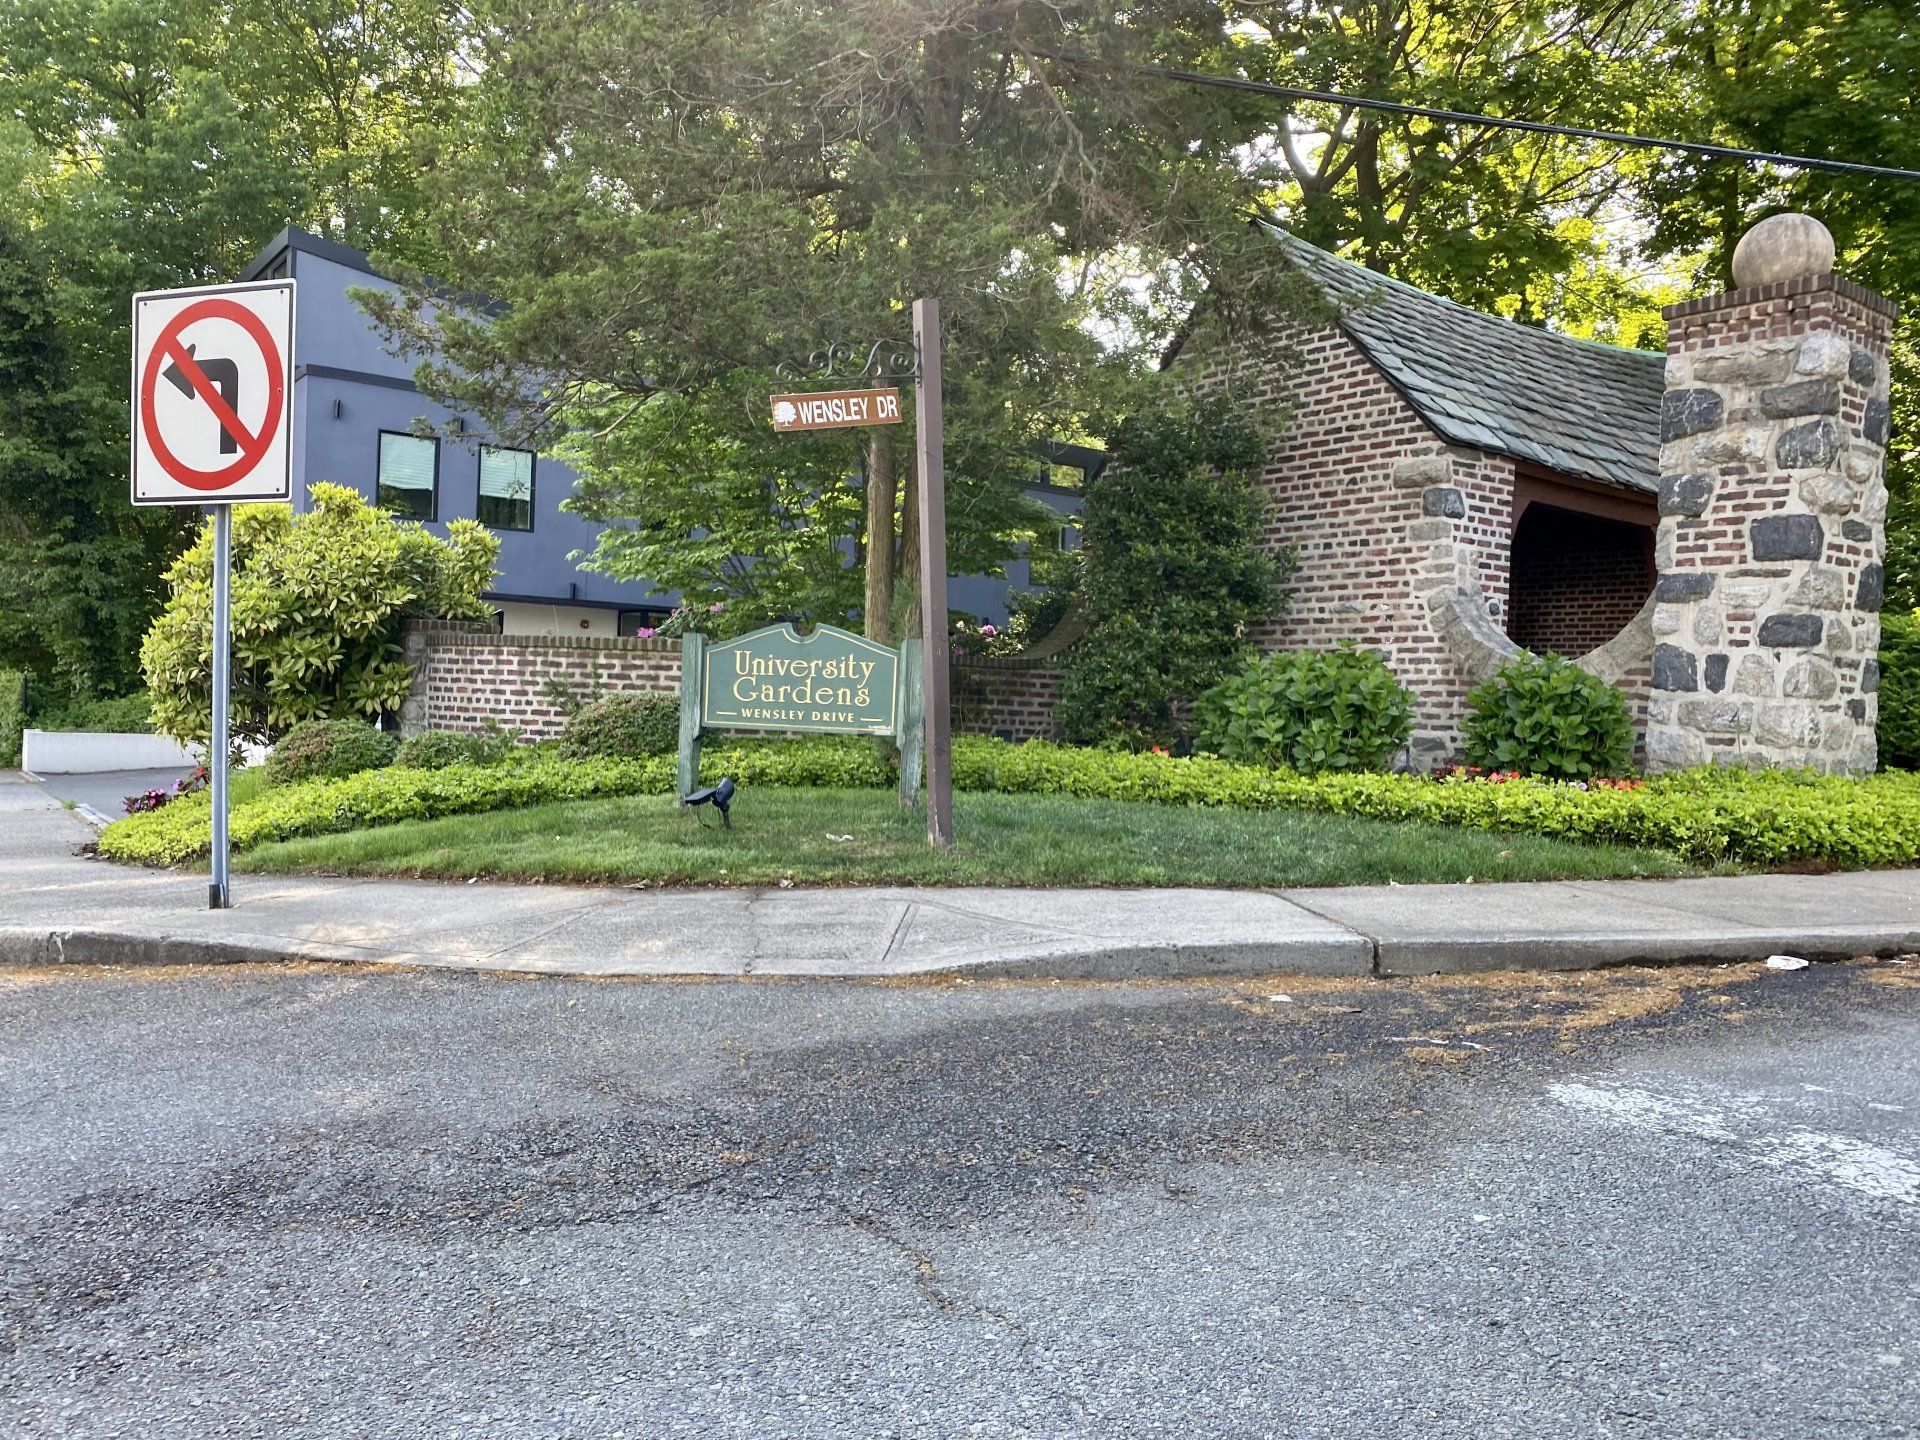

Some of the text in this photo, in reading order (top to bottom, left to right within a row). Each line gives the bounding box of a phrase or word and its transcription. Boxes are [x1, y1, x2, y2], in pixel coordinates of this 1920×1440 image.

[797, 395, 898, 424] WENSLEY DR
[734, 650, 876, 688] University
[732, 676, 871, 706] Gardens
[741, 708, 855, 723] WENSLEY DRIVE
